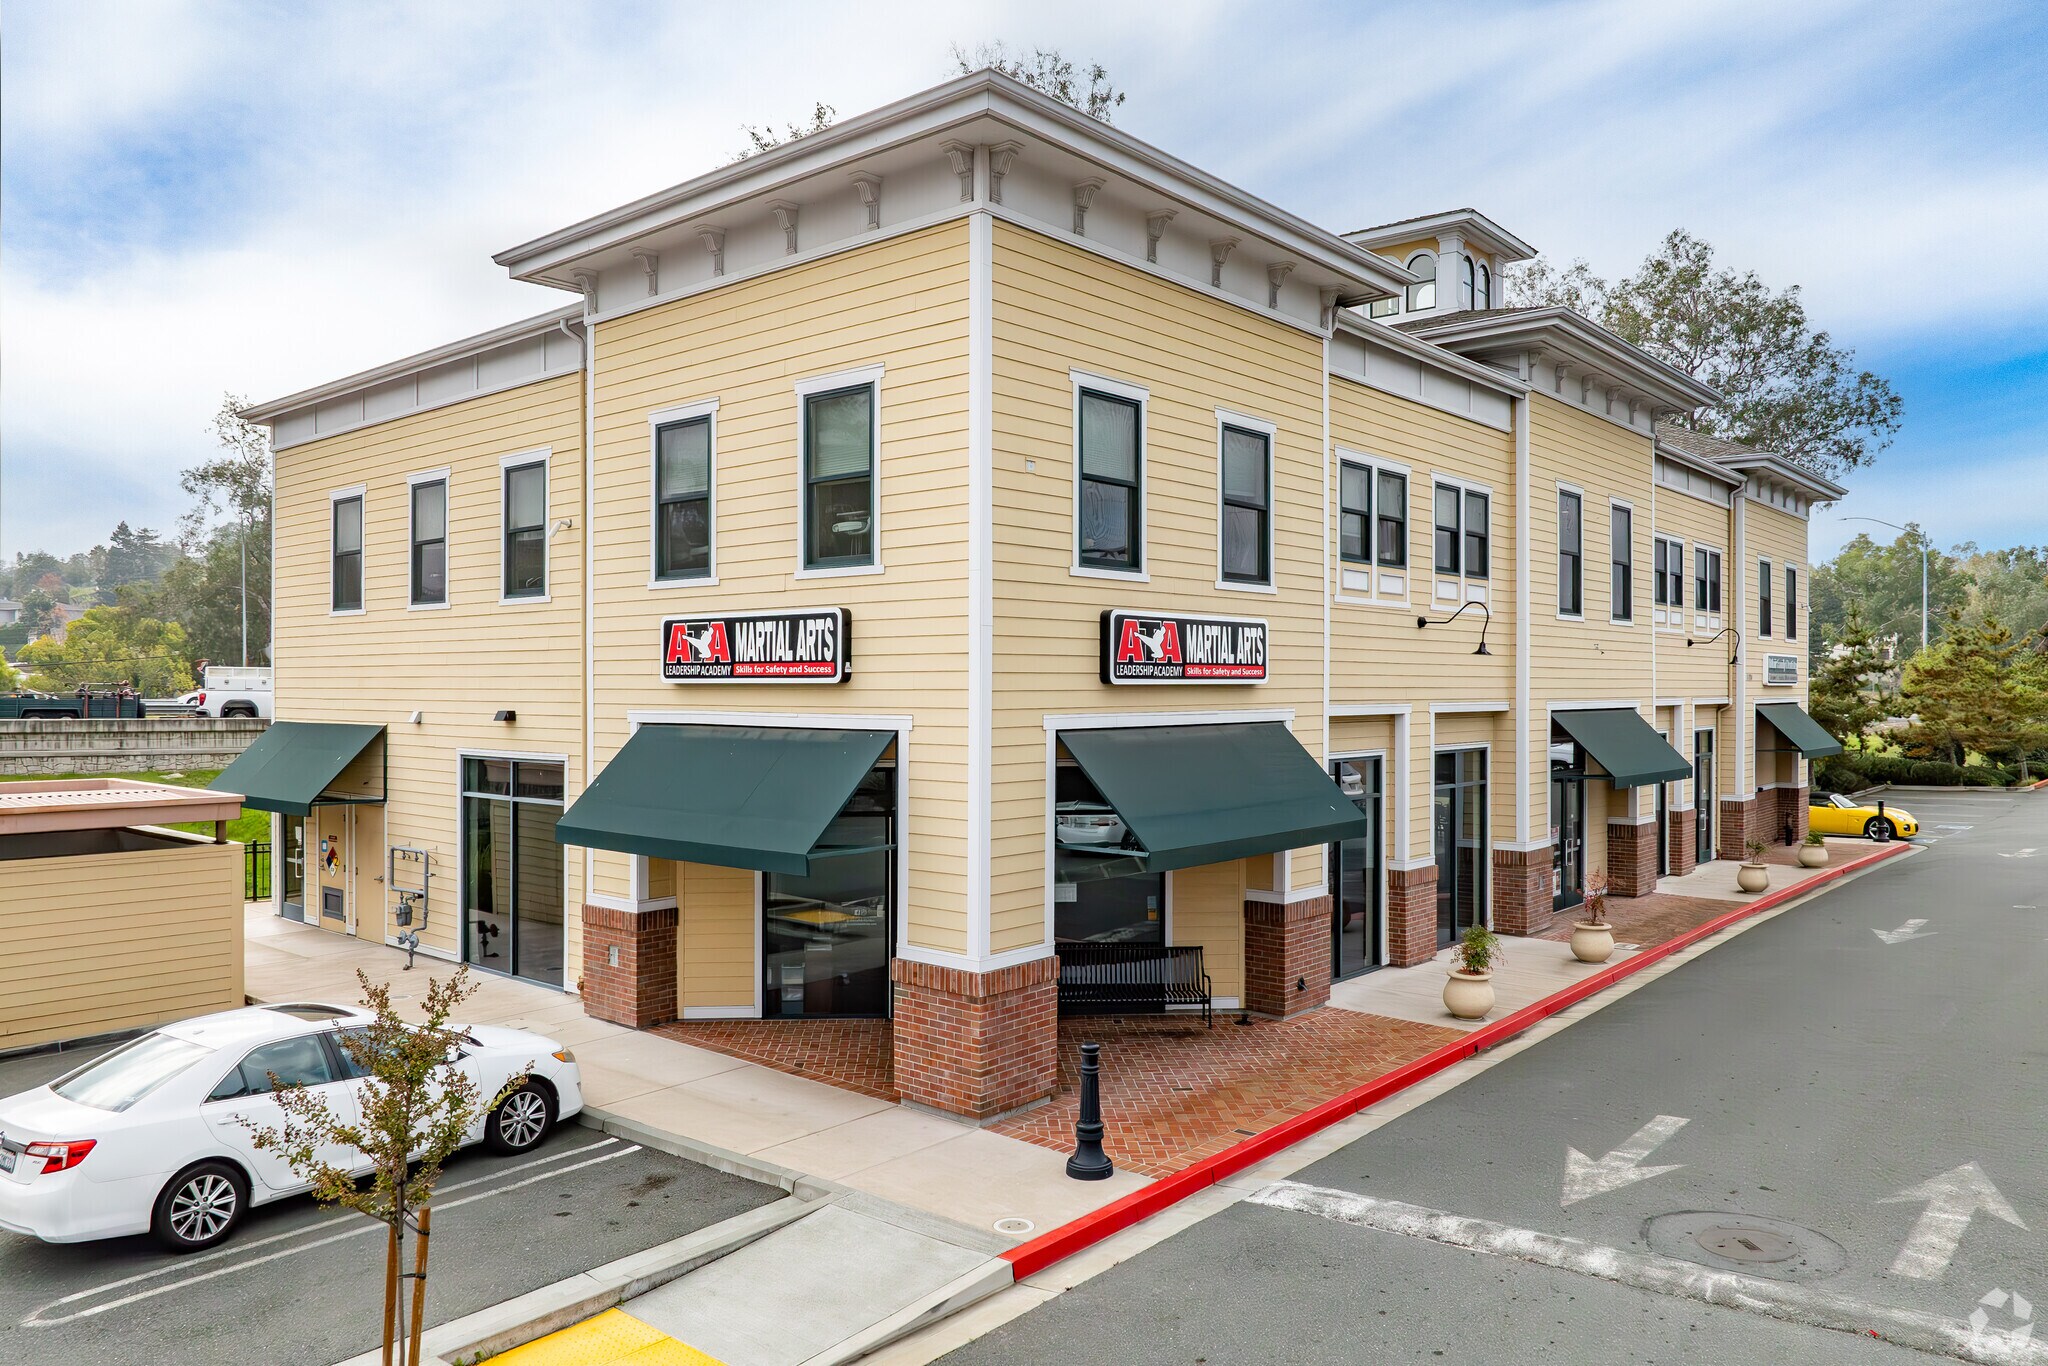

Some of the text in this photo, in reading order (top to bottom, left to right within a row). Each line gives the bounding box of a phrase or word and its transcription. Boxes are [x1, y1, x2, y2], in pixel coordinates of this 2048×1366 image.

[666, 621, 731, 663] ATA
[735, 617, 834, 662] MARTIAL ARTS
[1117, 619, 1182, 663] ATA
[1186, 624, 1264, 665] MARTIAL ARTS
[666, 665, 731, 676] LEADERSHIP ACADEMY
[735, 665, 832, 675] Skills for Safety and Success
[1116, 665, 1183, 677] LEADERSHIP ACADEMY
[1187, 667, 1202, 675] Skills
[1203, 667, 1212, 675] for
[1212, 667, 1230, 676] Safety
